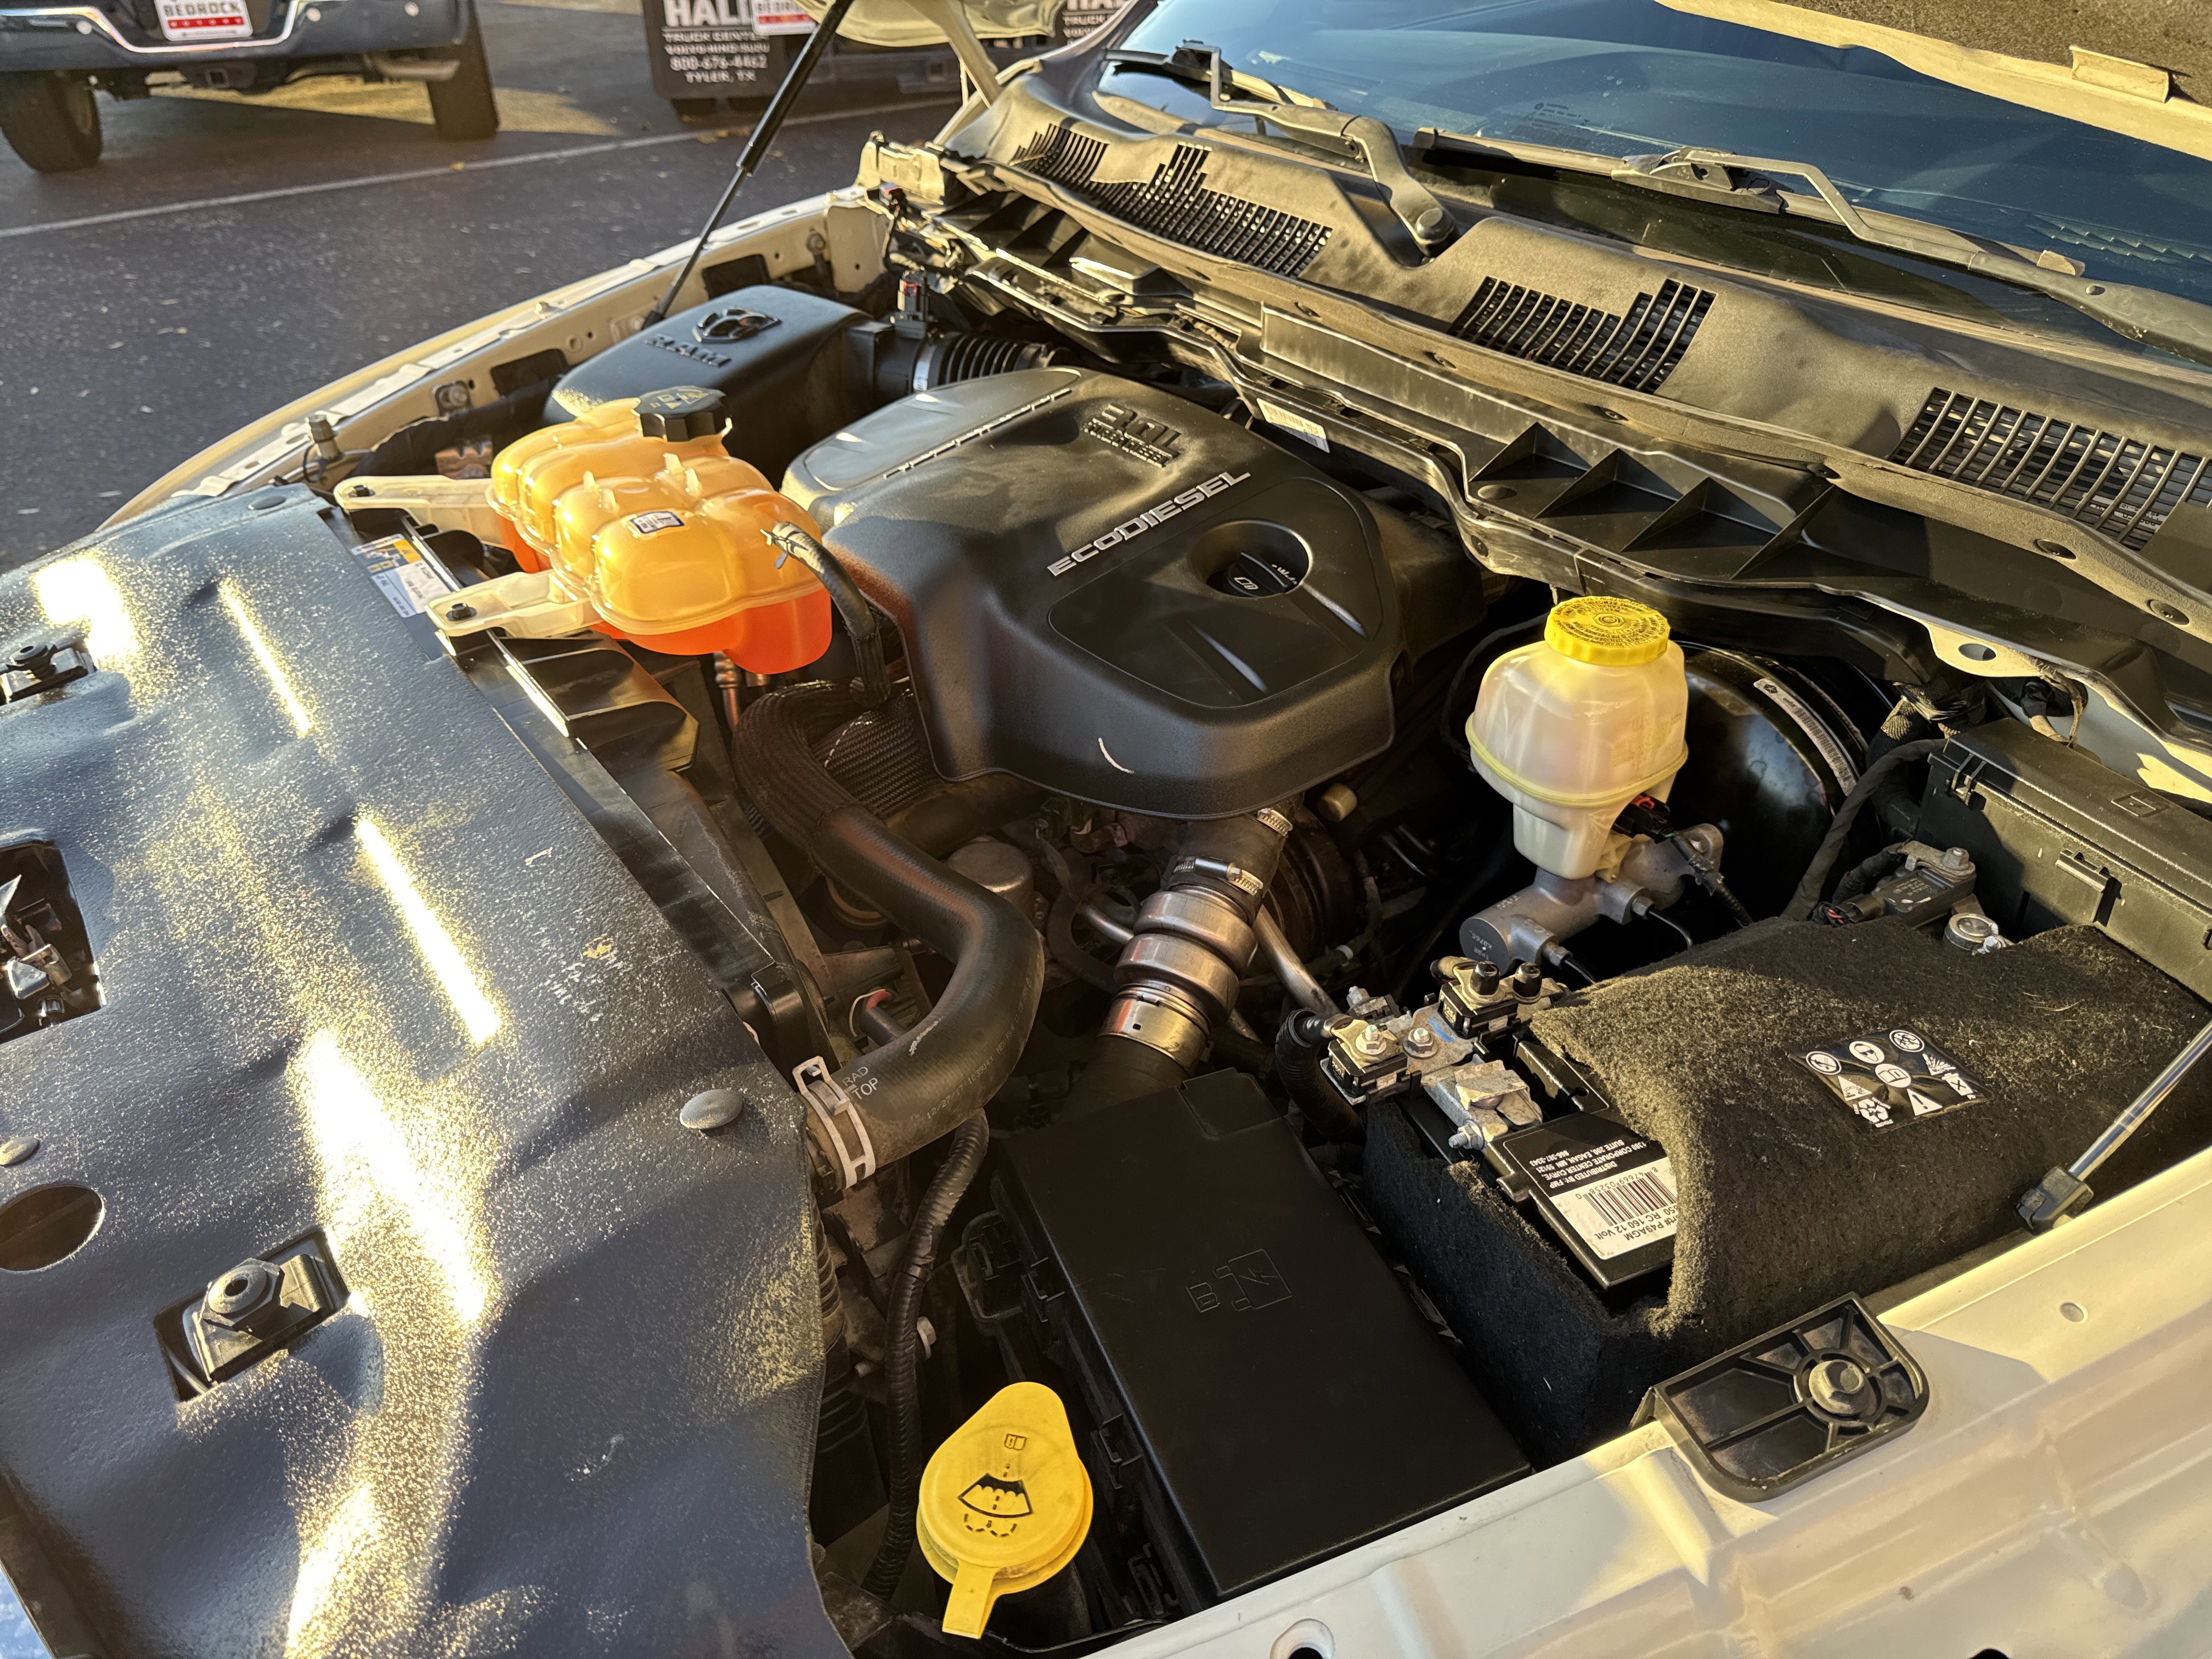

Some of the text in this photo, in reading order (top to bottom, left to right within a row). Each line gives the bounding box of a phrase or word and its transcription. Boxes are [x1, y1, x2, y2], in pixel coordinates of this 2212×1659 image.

[644, 333, 731, 368] RAM
[1047, 471, 1251, 576] ECODIESEL
[842, 1066, 868, 1087] RAD
[851, 1077, 878, 1099] TOP
[1536, 1139, 1625, 1173] SUITE 200, EAGAN, MN 55121
[1593, 1146, 1632, 1165] CORPORATE
[1567, 1160, 1593, 1174] CENTER
[1575, 1160, 1618, 1180] DISTRIBUTED
[1541, 1170, 1567, 1181] CURVE,
[1619, 1171, 1645, 1184] 47669
[1549, 1180, 1565, 1189] FMP
[1589, 1181, 1617, 1194] 03258
[1627, 1218, 1645, 1228] 160
[1645, 1212, 1661, 1222] RC
[1594, 1228, 1616, 1240] Volt
[1614, 1224, 1627, 1233] 12
[1623, 1221, 1664, 1241] P49AGM
